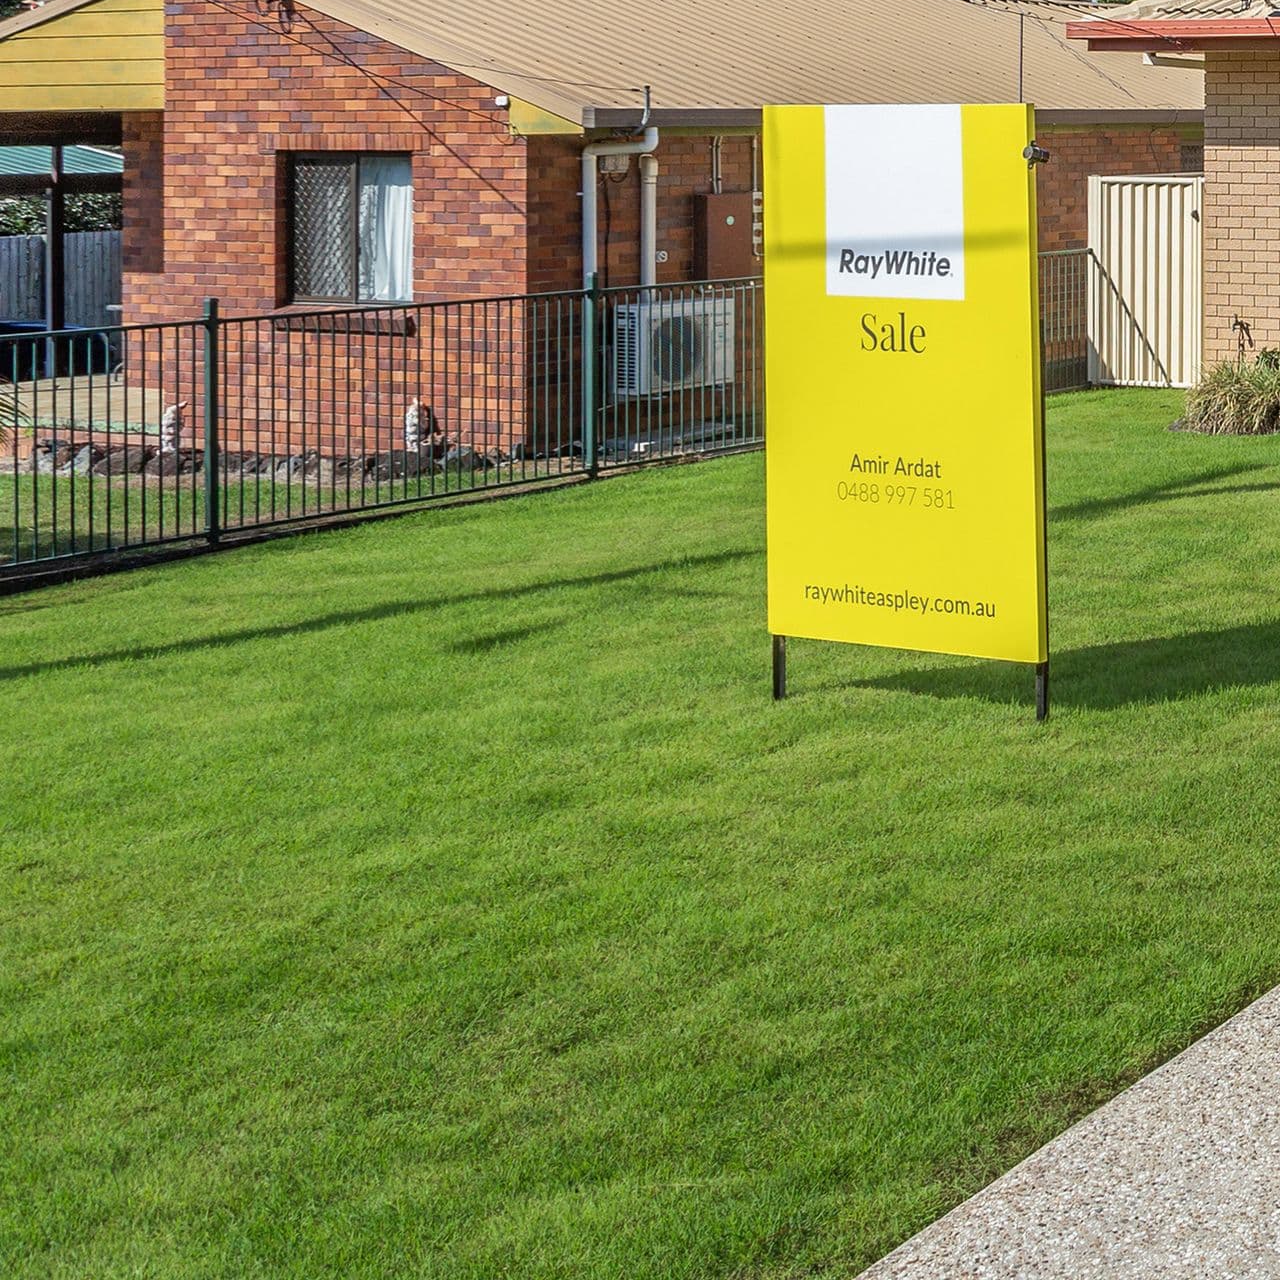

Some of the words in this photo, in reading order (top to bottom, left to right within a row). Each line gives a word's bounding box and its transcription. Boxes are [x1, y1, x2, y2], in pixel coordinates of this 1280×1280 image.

[861, 312, 927, 354] Sale
[850, 453, 889, 474] Amir
[894, 456, 942, 479] Ardat
[837, 480, 880, 504] 0488
[885, 484, 917, 506] 997
[923, 487, 955, 510] 581
[804, 583, 996, 618] raywhiteaspley.com.au
